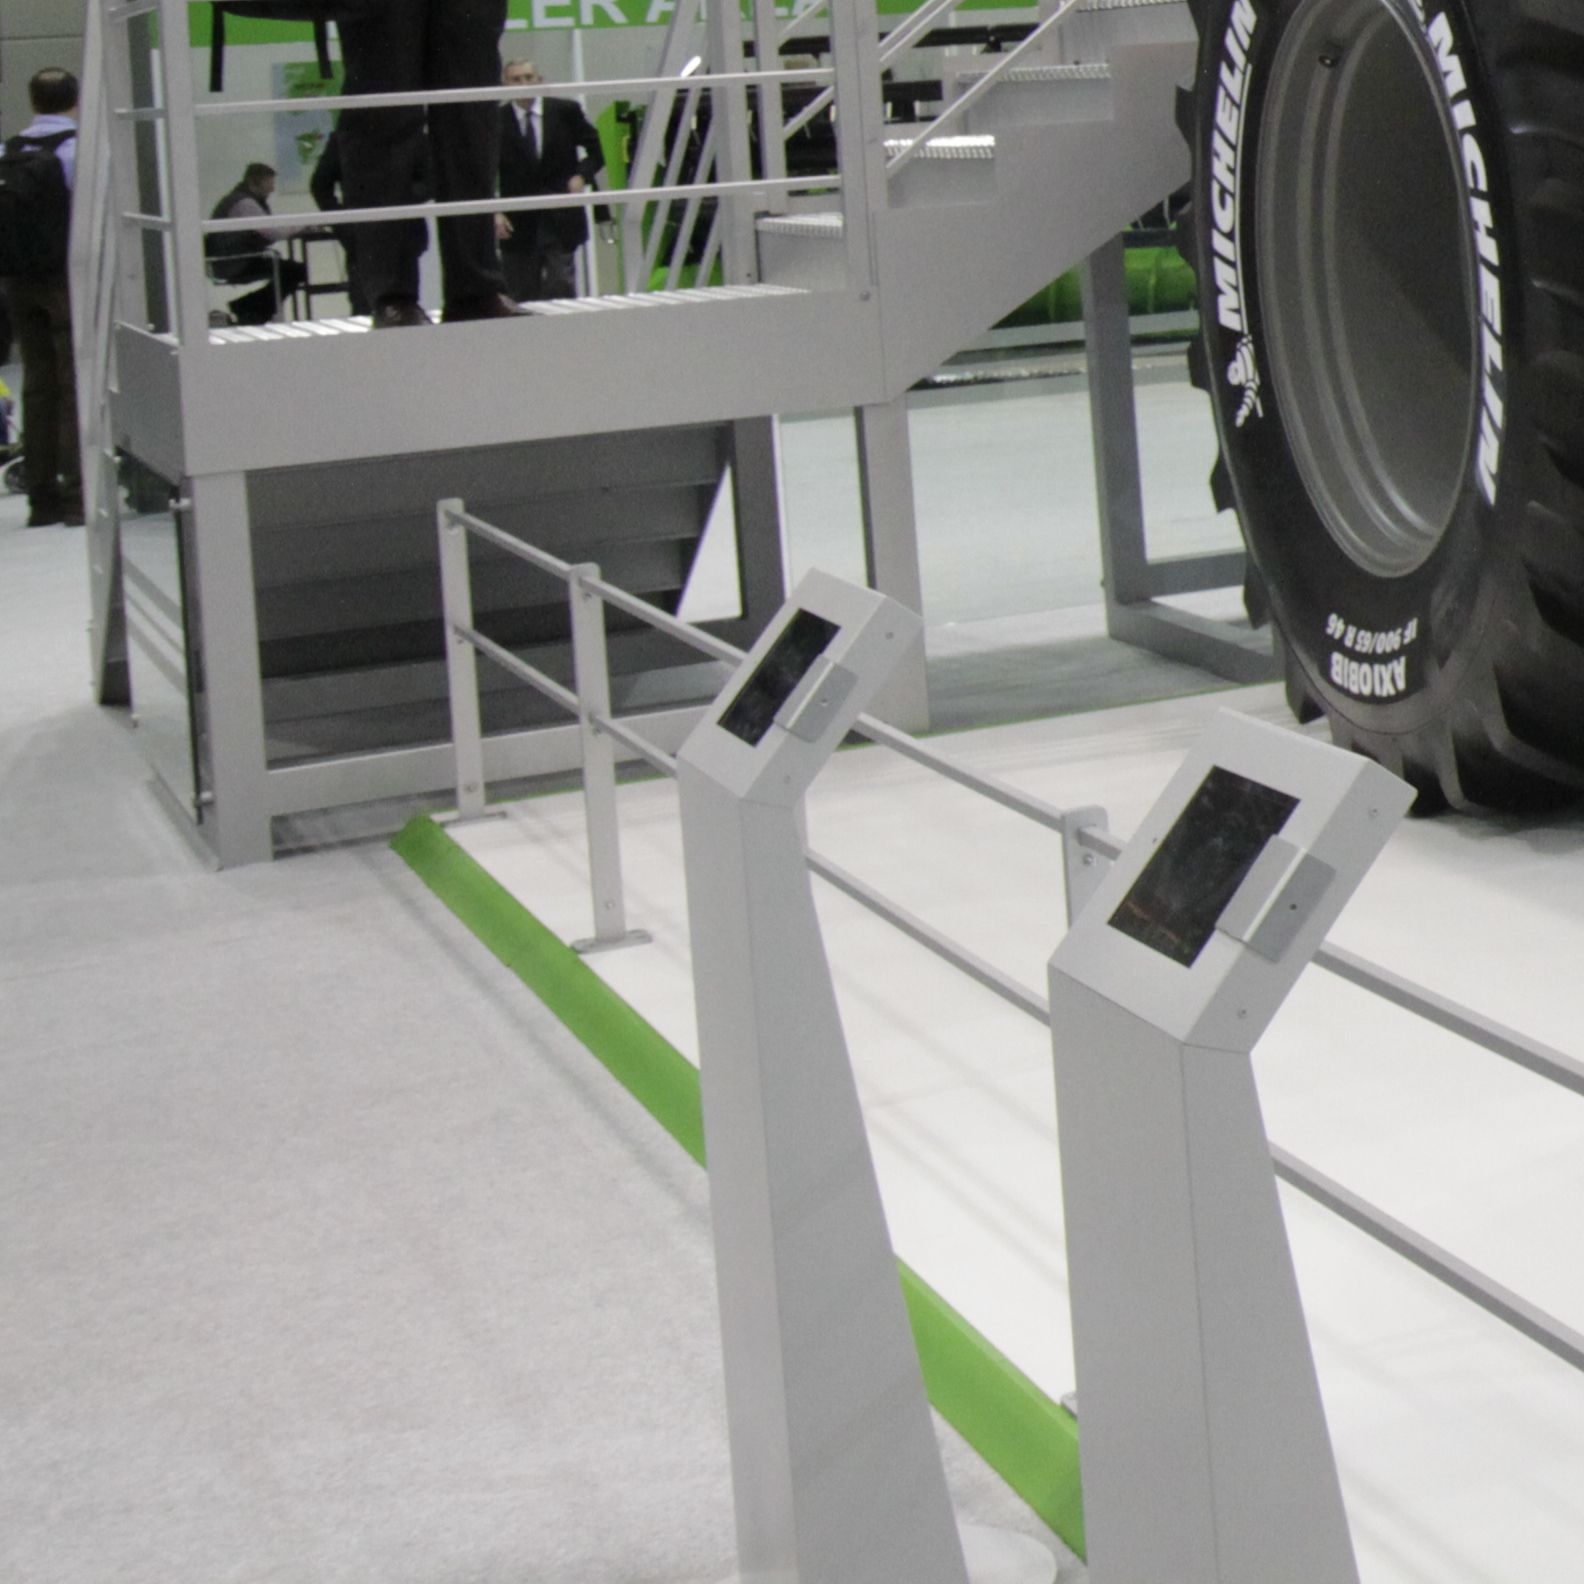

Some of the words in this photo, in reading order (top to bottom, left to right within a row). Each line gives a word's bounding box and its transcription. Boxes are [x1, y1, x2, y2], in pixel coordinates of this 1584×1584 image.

[1427, 11, 1504, 505] MICHELIN
[1326, 613, 1346, 640] 46
[1343, 624, 1357, 648] R
[1354, 627, 1403, 654] 900/65
[1330, 651, 1406, 698] AXIOBIB
